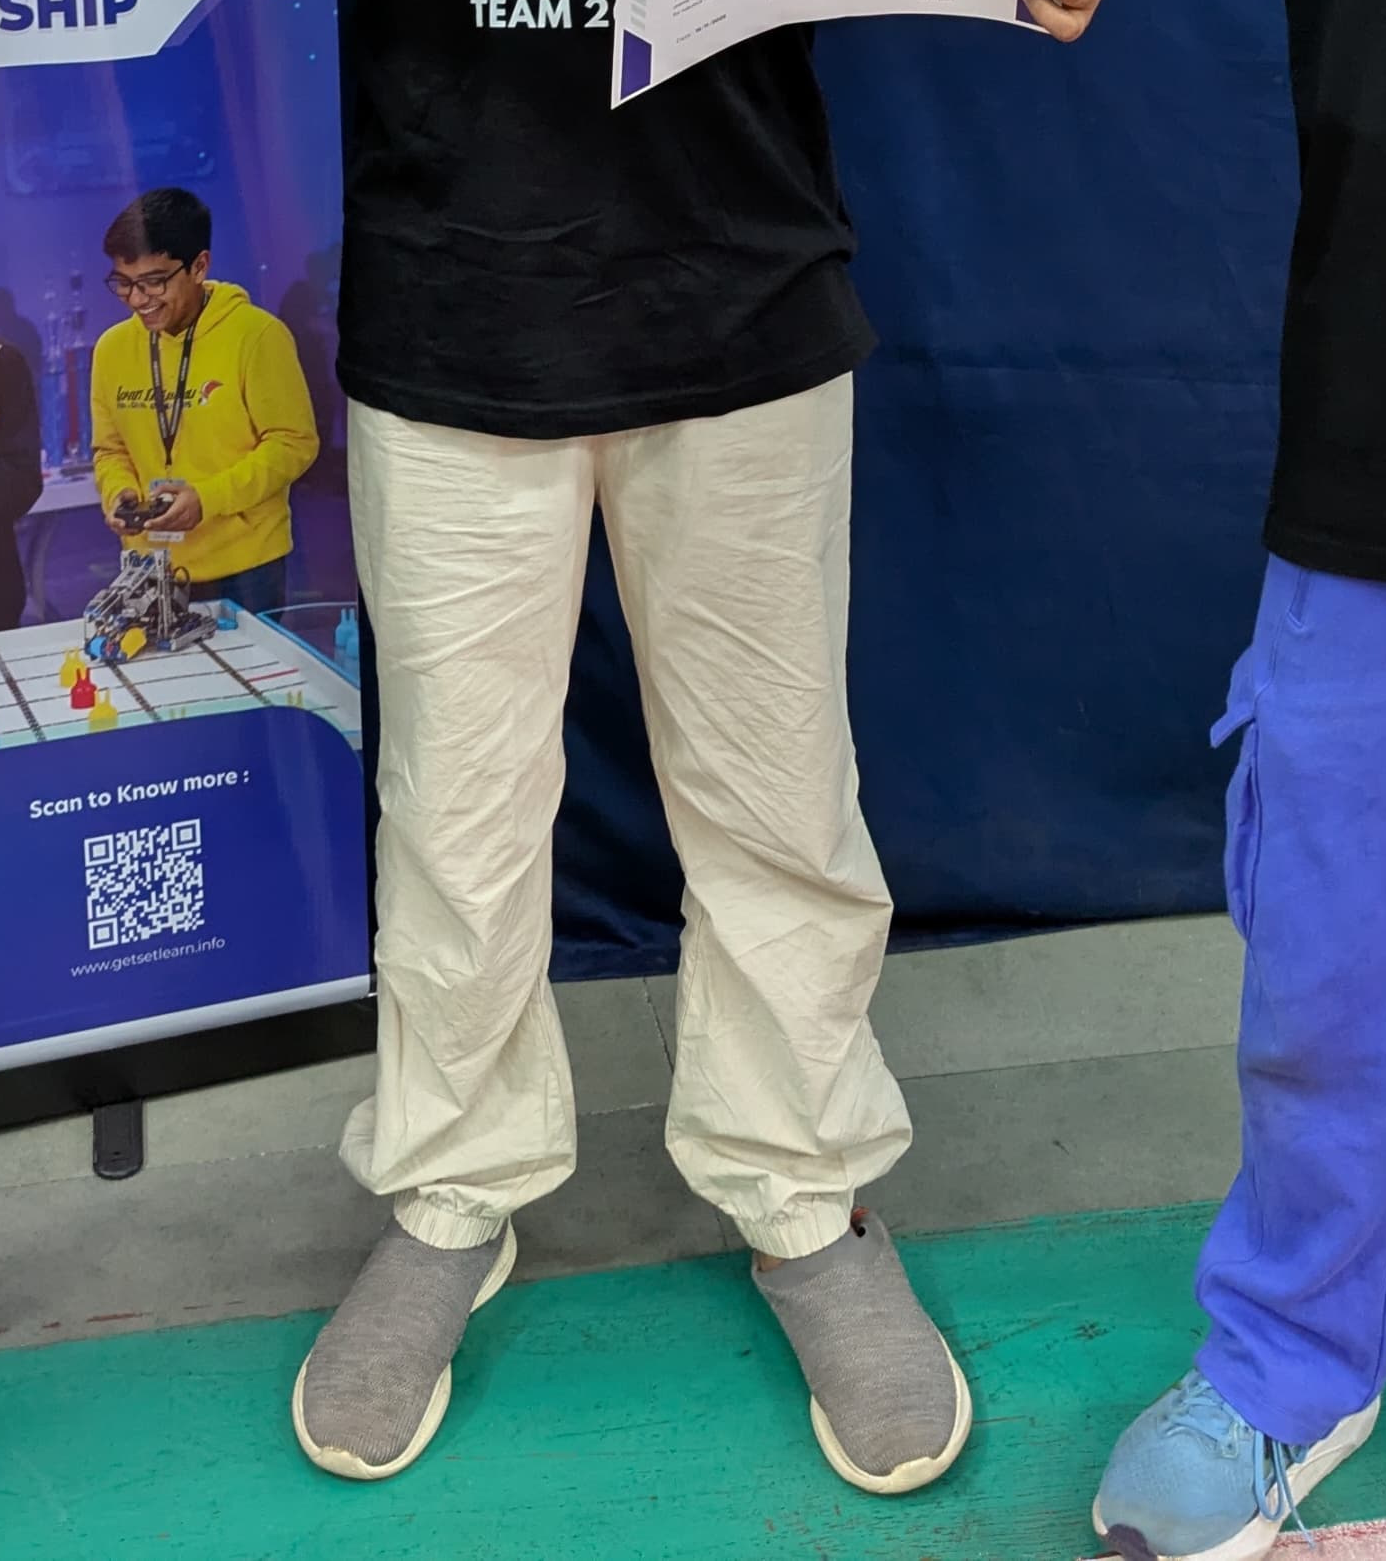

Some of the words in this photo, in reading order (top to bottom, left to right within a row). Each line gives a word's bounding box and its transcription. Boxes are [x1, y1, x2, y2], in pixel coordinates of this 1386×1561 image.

[28, 795, 83, 820] Scan
[87, 789, 113, 809] to
[116, 779, 179, 805] Know
[182, 769, 239, 793] more
[70, 936, 226, 978] www.getsetlearn.info
